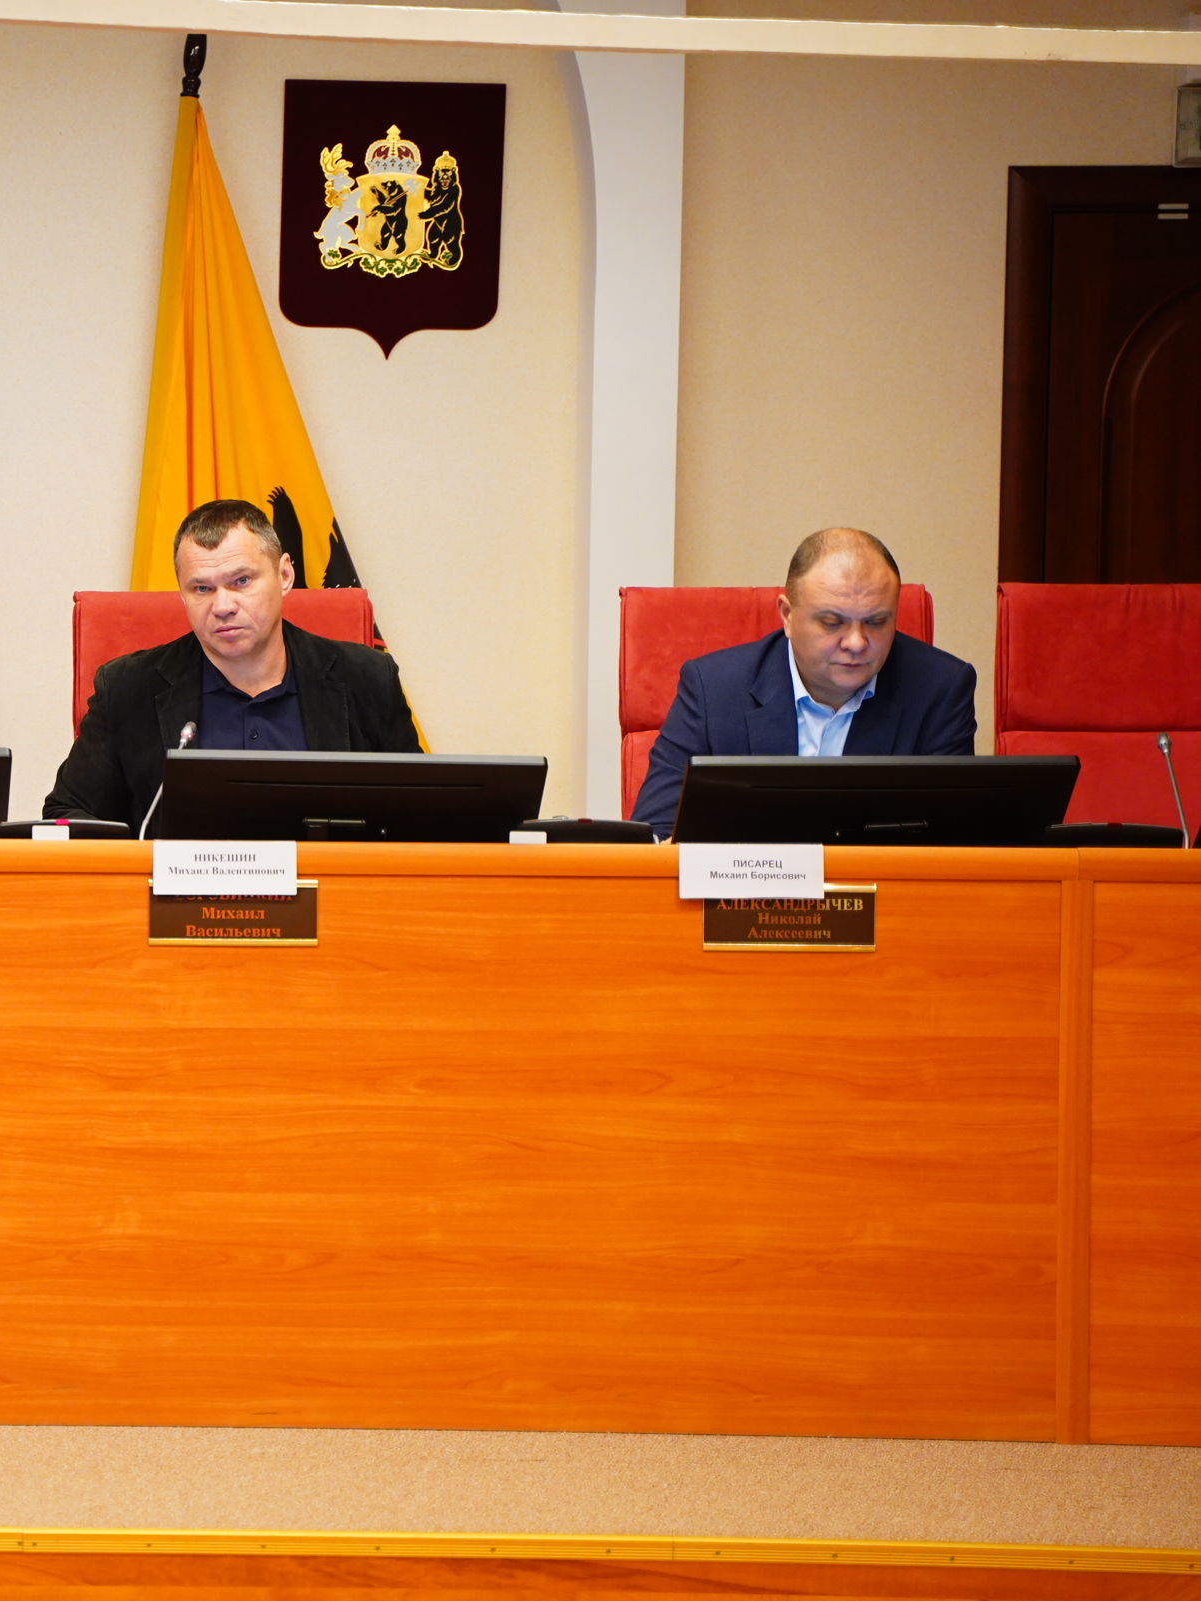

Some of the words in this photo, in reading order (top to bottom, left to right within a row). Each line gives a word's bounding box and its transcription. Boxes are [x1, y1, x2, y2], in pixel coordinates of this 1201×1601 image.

[194, 853, 256, 862] НИКЕШИН
[733, 859, 783, 870] ПИСАРЕЦ
[168, 866, 209, 875] Михаил
[212, 867, 286, 876] Валентинович
[709, 871, 748, 880] Михаил
[751, 871, 806, 881] Борисович
[716, 898, 864, 911] АЛЕКСАНДРЫЧЕВ
[201, 907, 266, 920] Михаил
[758, 911, 822, 925] Николай
[185, 925, 281, 938] Васильевич
[747, 927, 832, 939] Алексеевич
